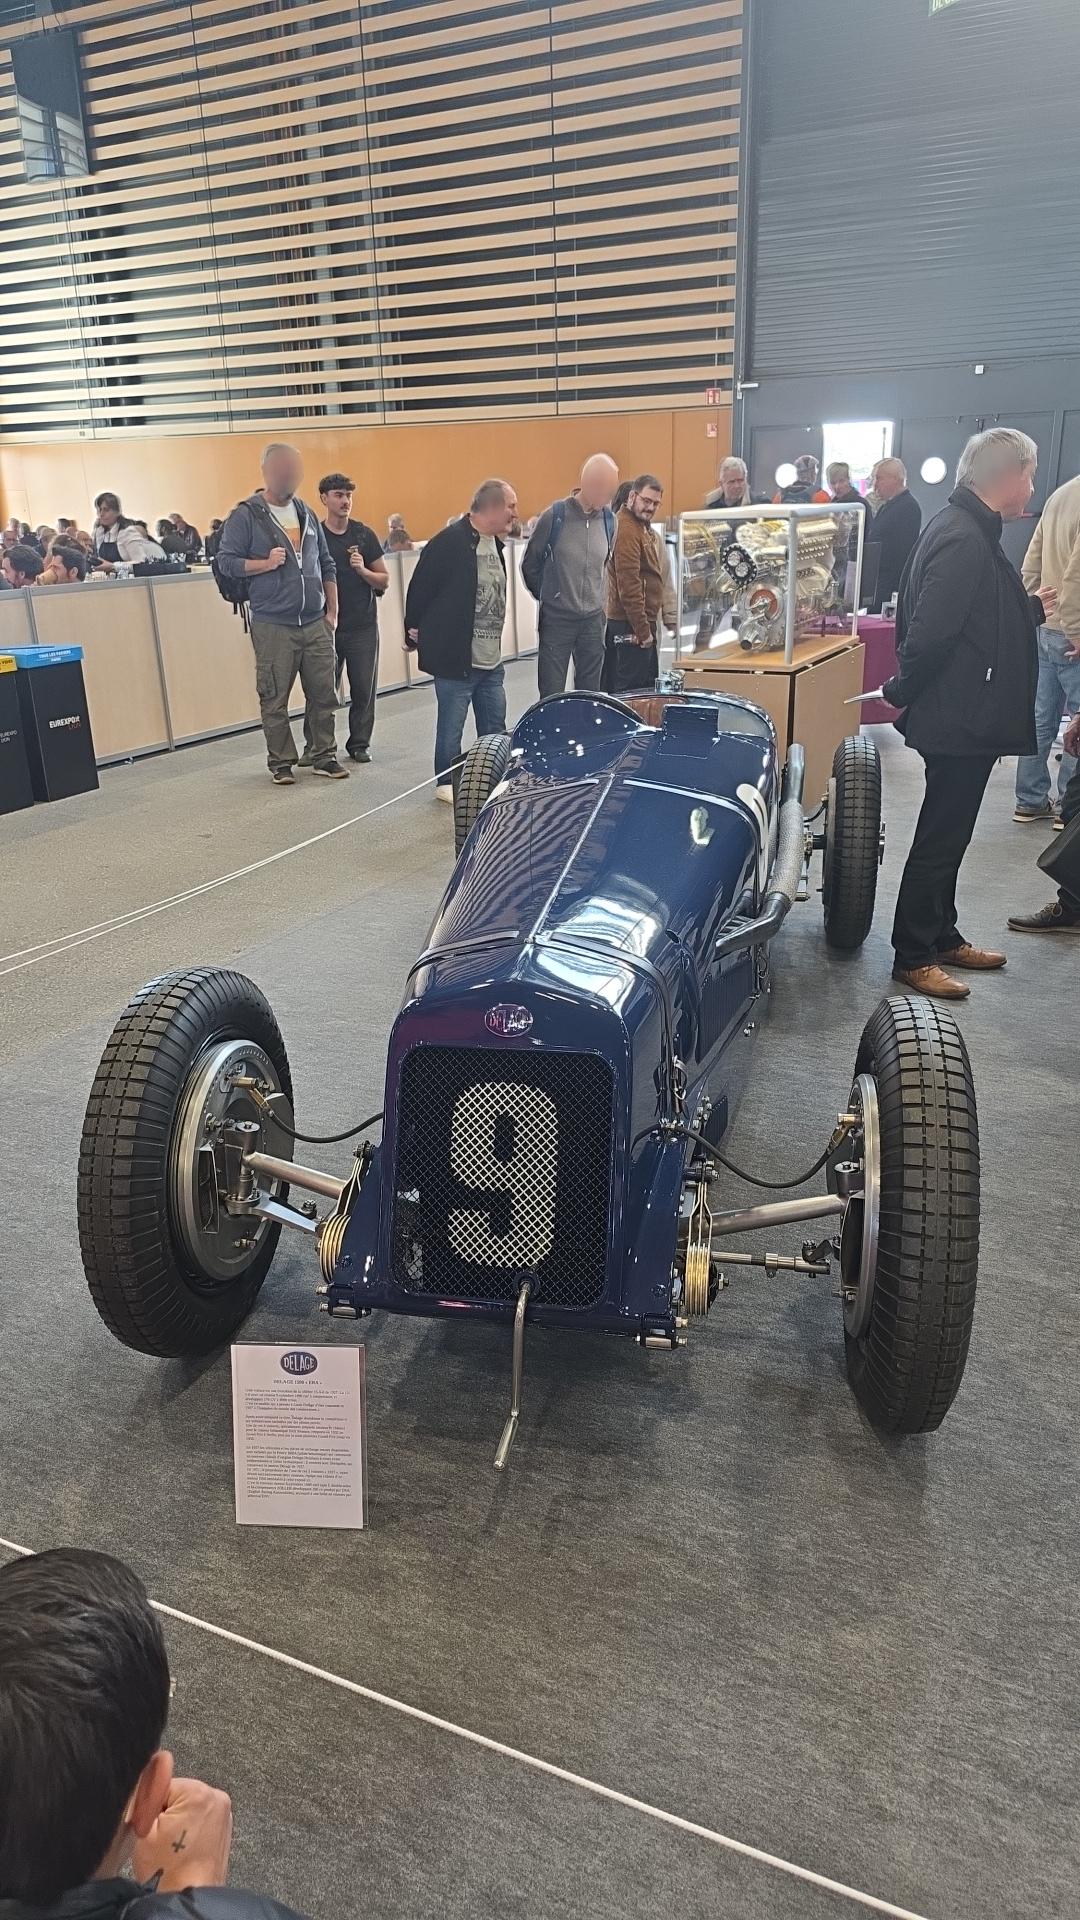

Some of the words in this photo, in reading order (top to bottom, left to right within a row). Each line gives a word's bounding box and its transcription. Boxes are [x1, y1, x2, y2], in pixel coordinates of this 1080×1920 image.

[49, 717, 76, 729] EUREXPO
[449, 1081, 558, 1268] 9
[283, 1353, 315, 1372] DELAGE
